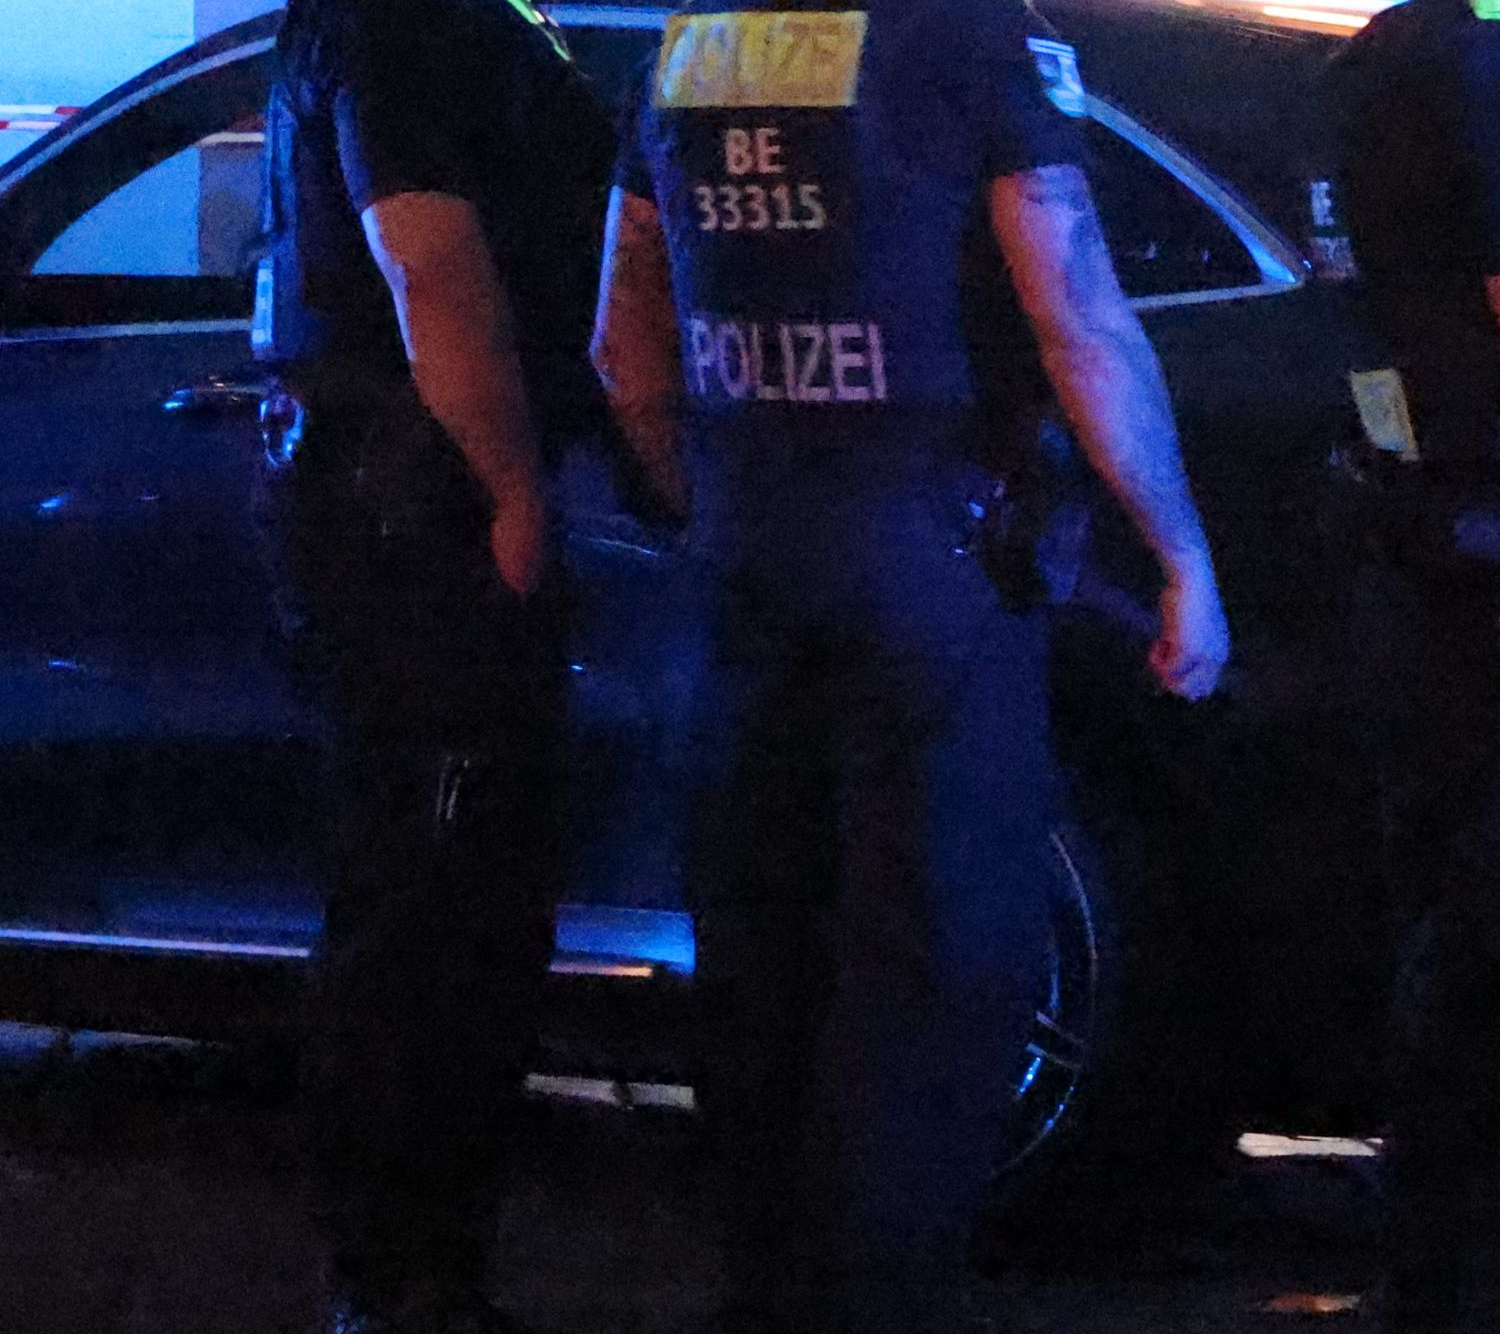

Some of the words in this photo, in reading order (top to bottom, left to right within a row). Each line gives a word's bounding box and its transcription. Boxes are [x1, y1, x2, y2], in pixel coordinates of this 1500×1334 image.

[723, 127, 787, 177] BE
[694, 183, 828, 231] 33315
[689, 318, 888, 403] POLIZEI
